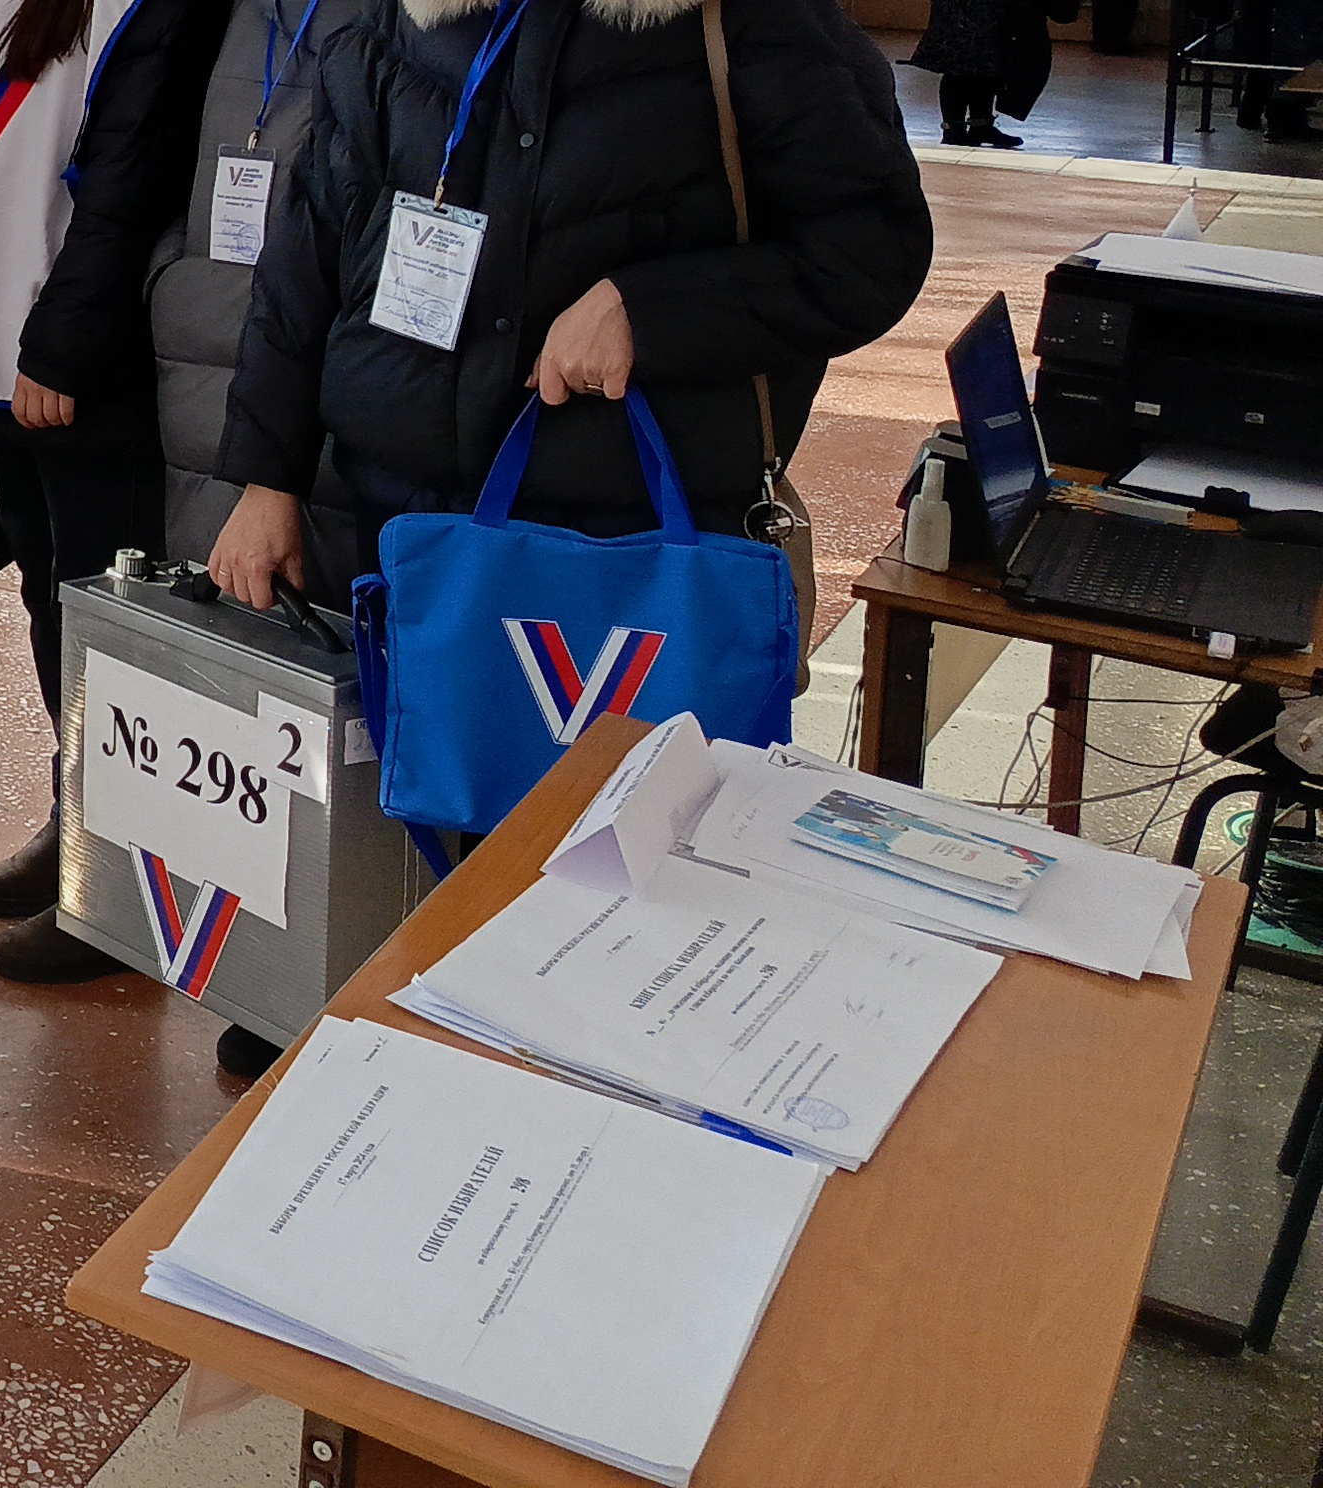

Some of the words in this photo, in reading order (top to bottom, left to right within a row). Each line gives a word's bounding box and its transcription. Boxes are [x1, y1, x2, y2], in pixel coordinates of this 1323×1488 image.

[102, 703, 158, 777] №
[175, 737, 267, 824] 298
[277, 722, 303, 776] 2
[418, 1214, 458, 1262] СПИСОК
[447, 1146, 504, 1215] ИЗБИРАТЕЛЕЙ
[510, 1177, 530, 1193] 298
[269, 1204, 297, 1234] ВЫБОРЫ
